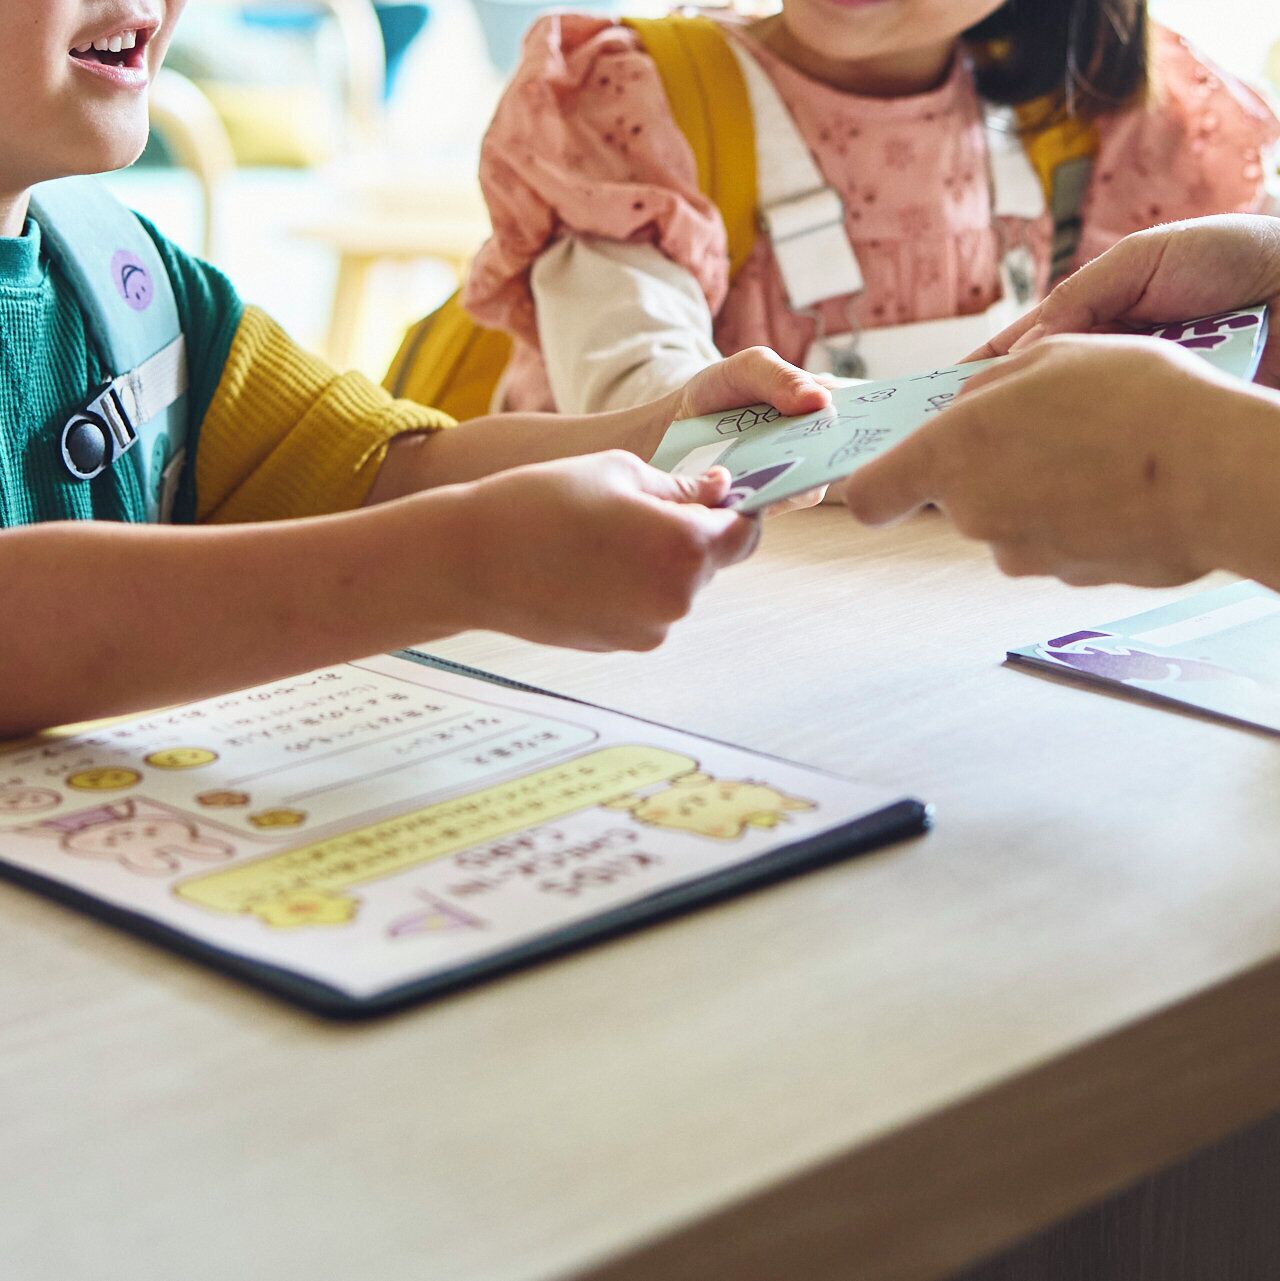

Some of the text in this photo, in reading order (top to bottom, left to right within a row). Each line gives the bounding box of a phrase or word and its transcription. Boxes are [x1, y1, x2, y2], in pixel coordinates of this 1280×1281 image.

[284, 704, 444, 752] すきなたべもの
[462, 731, 558, 764] おなまえ
[449, 829, 637, 896] CHECK-IN
[452, 827, 563, 867] CARD
[538, 852, 661, 895] KIDS
